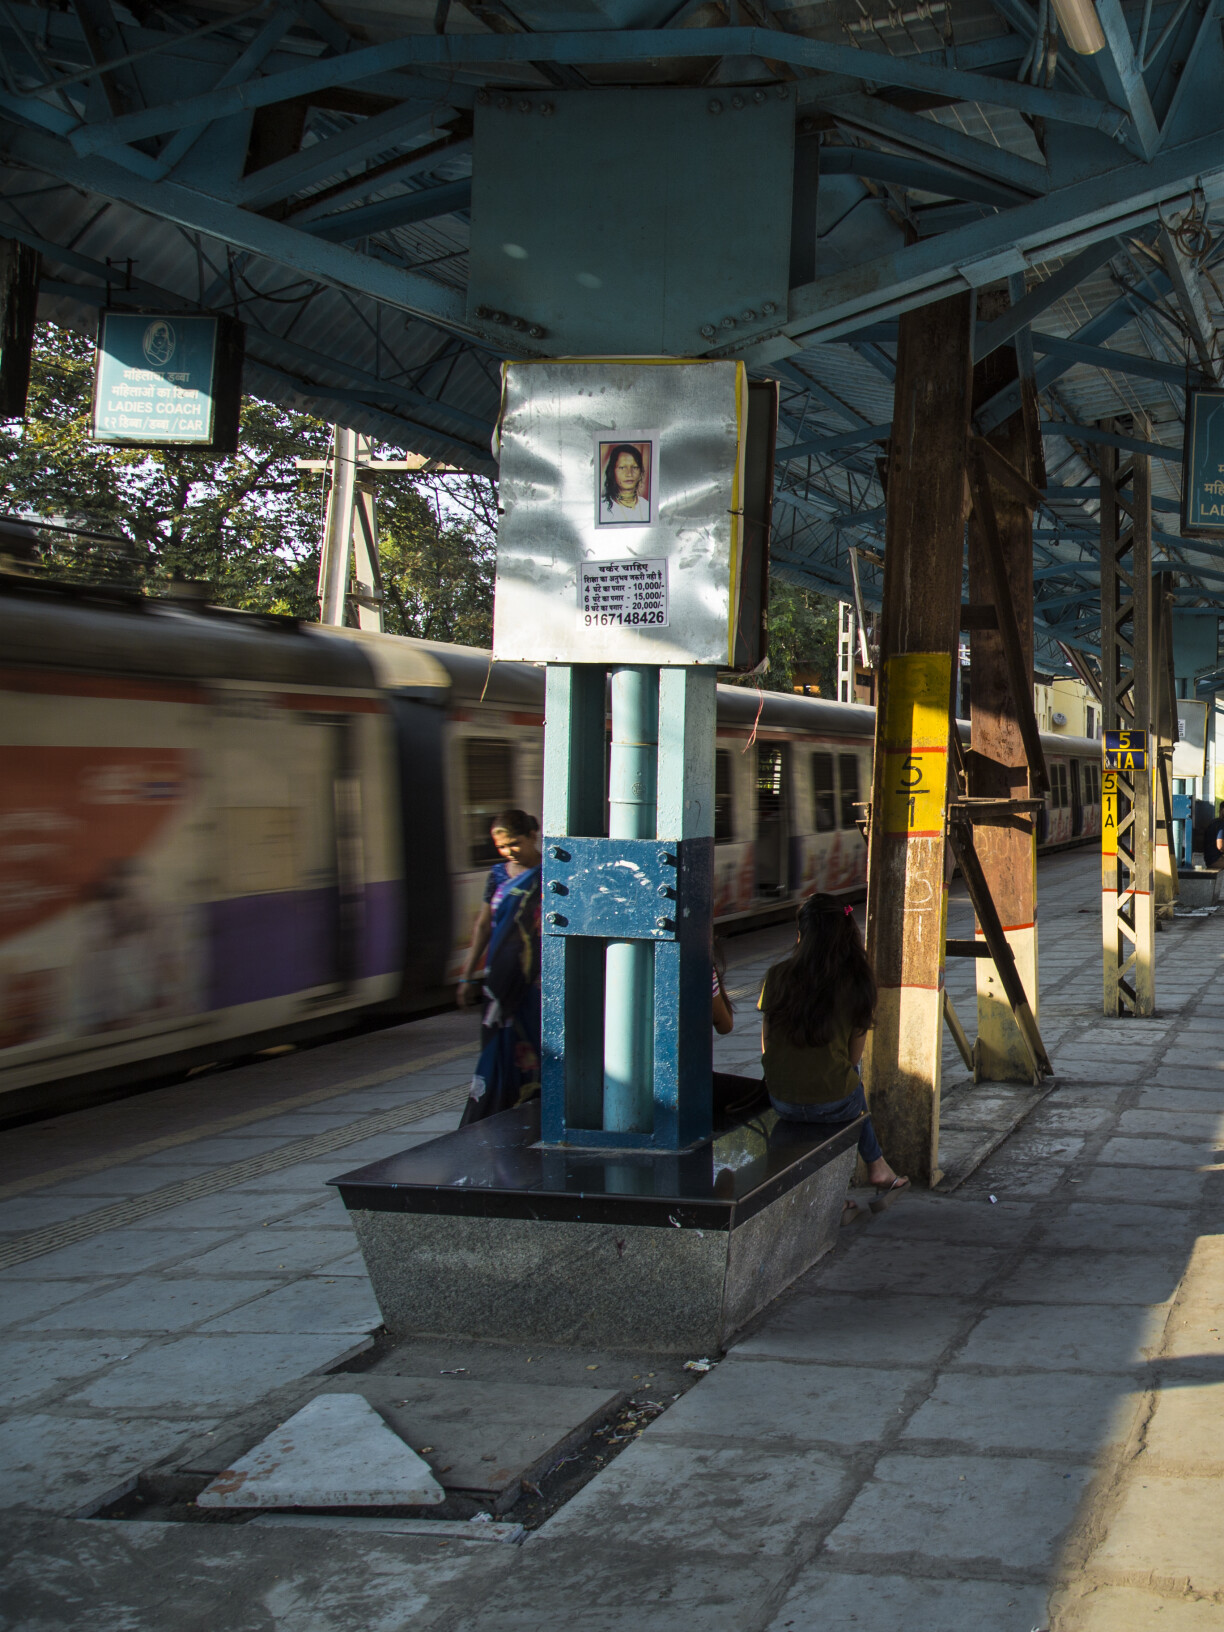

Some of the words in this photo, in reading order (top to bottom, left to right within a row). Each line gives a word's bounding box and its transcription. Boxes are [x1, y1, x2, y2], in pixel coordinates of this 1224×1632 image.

[167, 372, 190, 382] डब्बा
[112, 382, 156, 398] महिलाओं
[157, 387, 171, 398] का
[173, 384, 200, 400] डिब्बा
[108, 400, 153, 413] LADIES
[156, 402, 201, 415] COACH
[621, 562, 648, 572] चाहिए
[609, 575, 628, 584] अनुभव
[658, 570, 662, 581] है
[633, 582, 664, 591] 10,000/-
[634, 592, 664, 601] 15,000/-
[632, 601, 663, 610] 20,000/-
[584, 611, 664, 626] 9167148426
[1119, 732, 1131, 749] 5
[900, 756, 923, 787] 5
[1104, 774, 1114, 790] 5
[1106, 796, 1111, 812] 1
[906, 796, 916, 828] 1
[1104, 814, 1114, 828] A
[906, 870, 934, 904] 5
